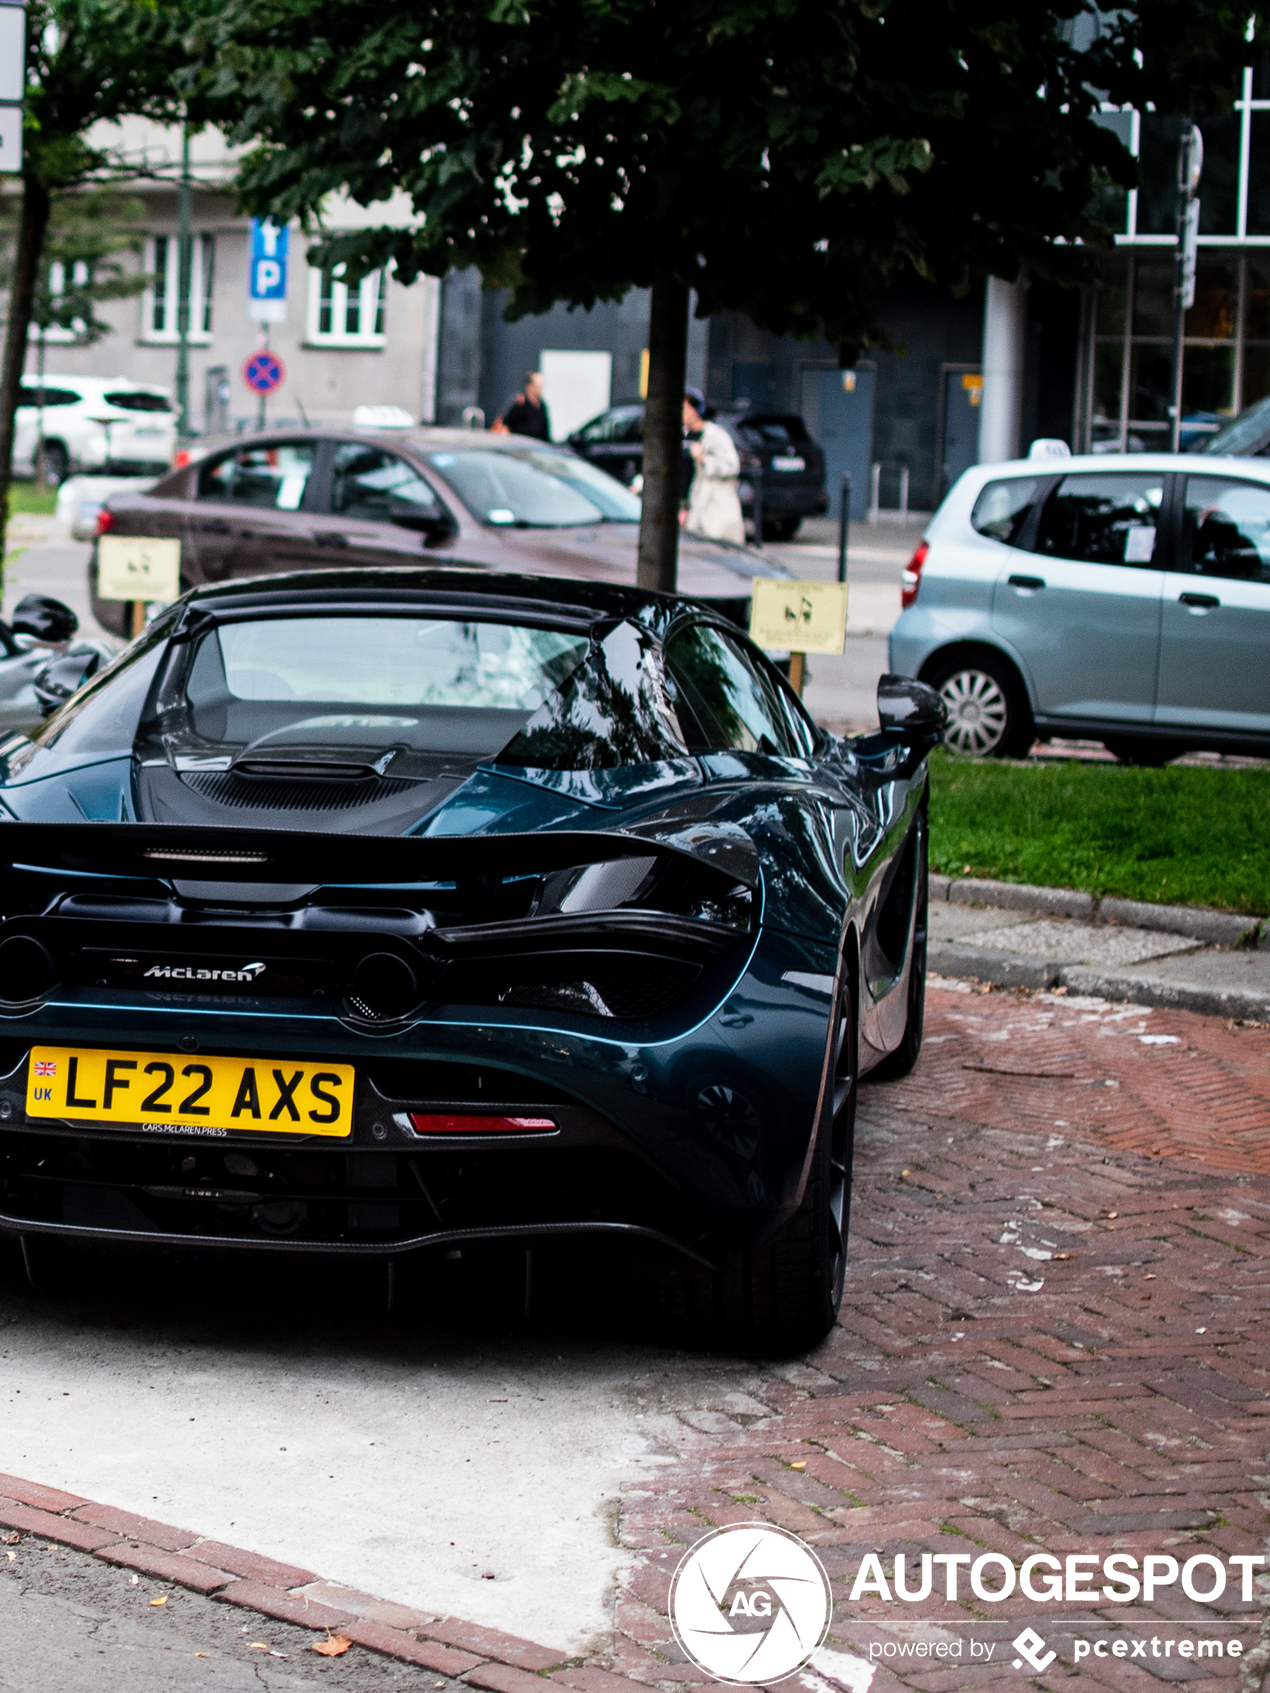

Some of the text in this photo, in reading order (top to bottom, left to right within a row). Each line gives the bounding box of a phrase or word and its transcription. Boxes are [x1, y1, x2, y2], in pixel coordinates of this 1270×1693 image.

[256, 260, 281, 295] P
[143, 965, 253, 982] McLaren
[33, 1087, 52, 1101] UK
[65, 1056, 344, 1125] LF22 AXS
